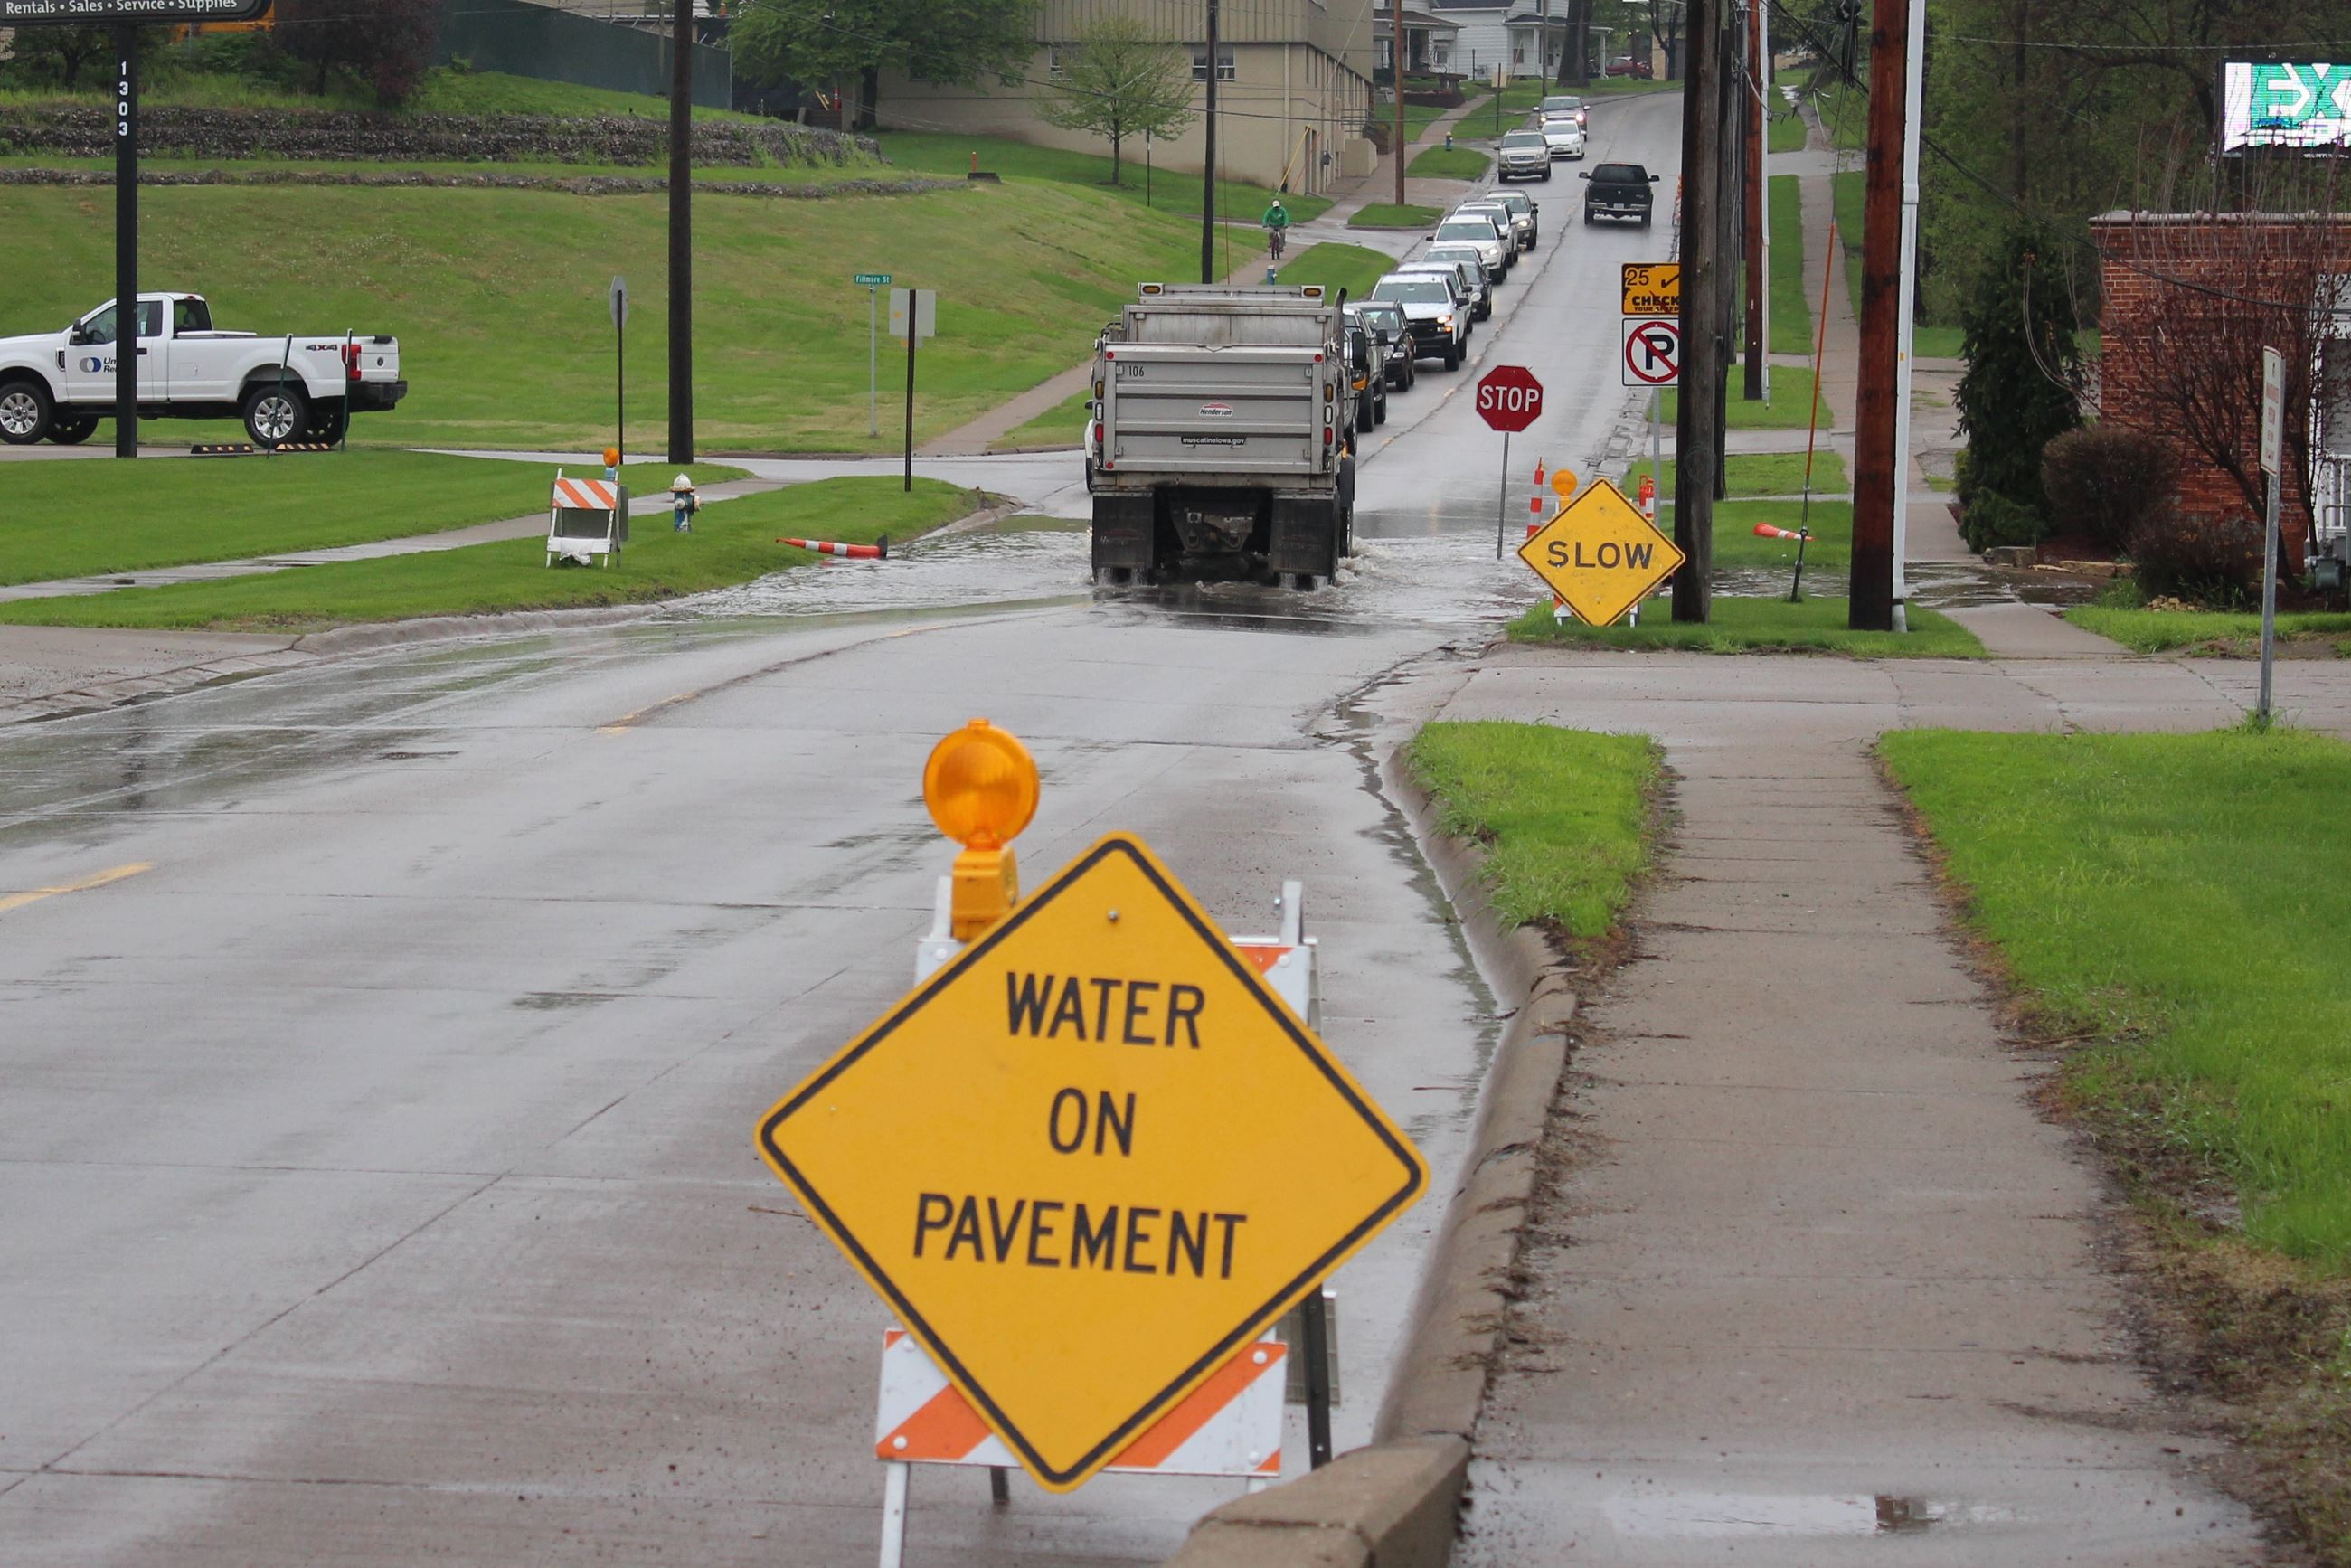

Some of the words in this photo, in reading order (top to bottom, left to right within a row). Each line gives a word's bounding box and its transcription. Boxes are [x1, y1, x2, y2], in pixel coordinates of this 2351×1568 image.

[6, 0, 55, 14] Rentals
[69, 0, 103, 12] Sales
[116, 0, 165, 11] Service
[118, 61, 128, 137] 1303
[855, 275, 880, 283] Fillmore
[883, 275, 890, 283] St
[1627, 269, 1649, 286] 25
[1632, 296, 1680, 306] CHECK
[1129, 365, 1144, 377] 106
[1479, 384, 1540, 412] STOP
[1200, 408, 1232, 416] Henderson
[1183, 437, 1245, 446] muscatineiowa.gov
[1547, 541, 1653, 569] SLOW
[1006, 971, 1205, 1049] WATER
[1048, 1087, 1136, 1157] ON
[913, 1193, 1248, 1280] PAVEMENT
